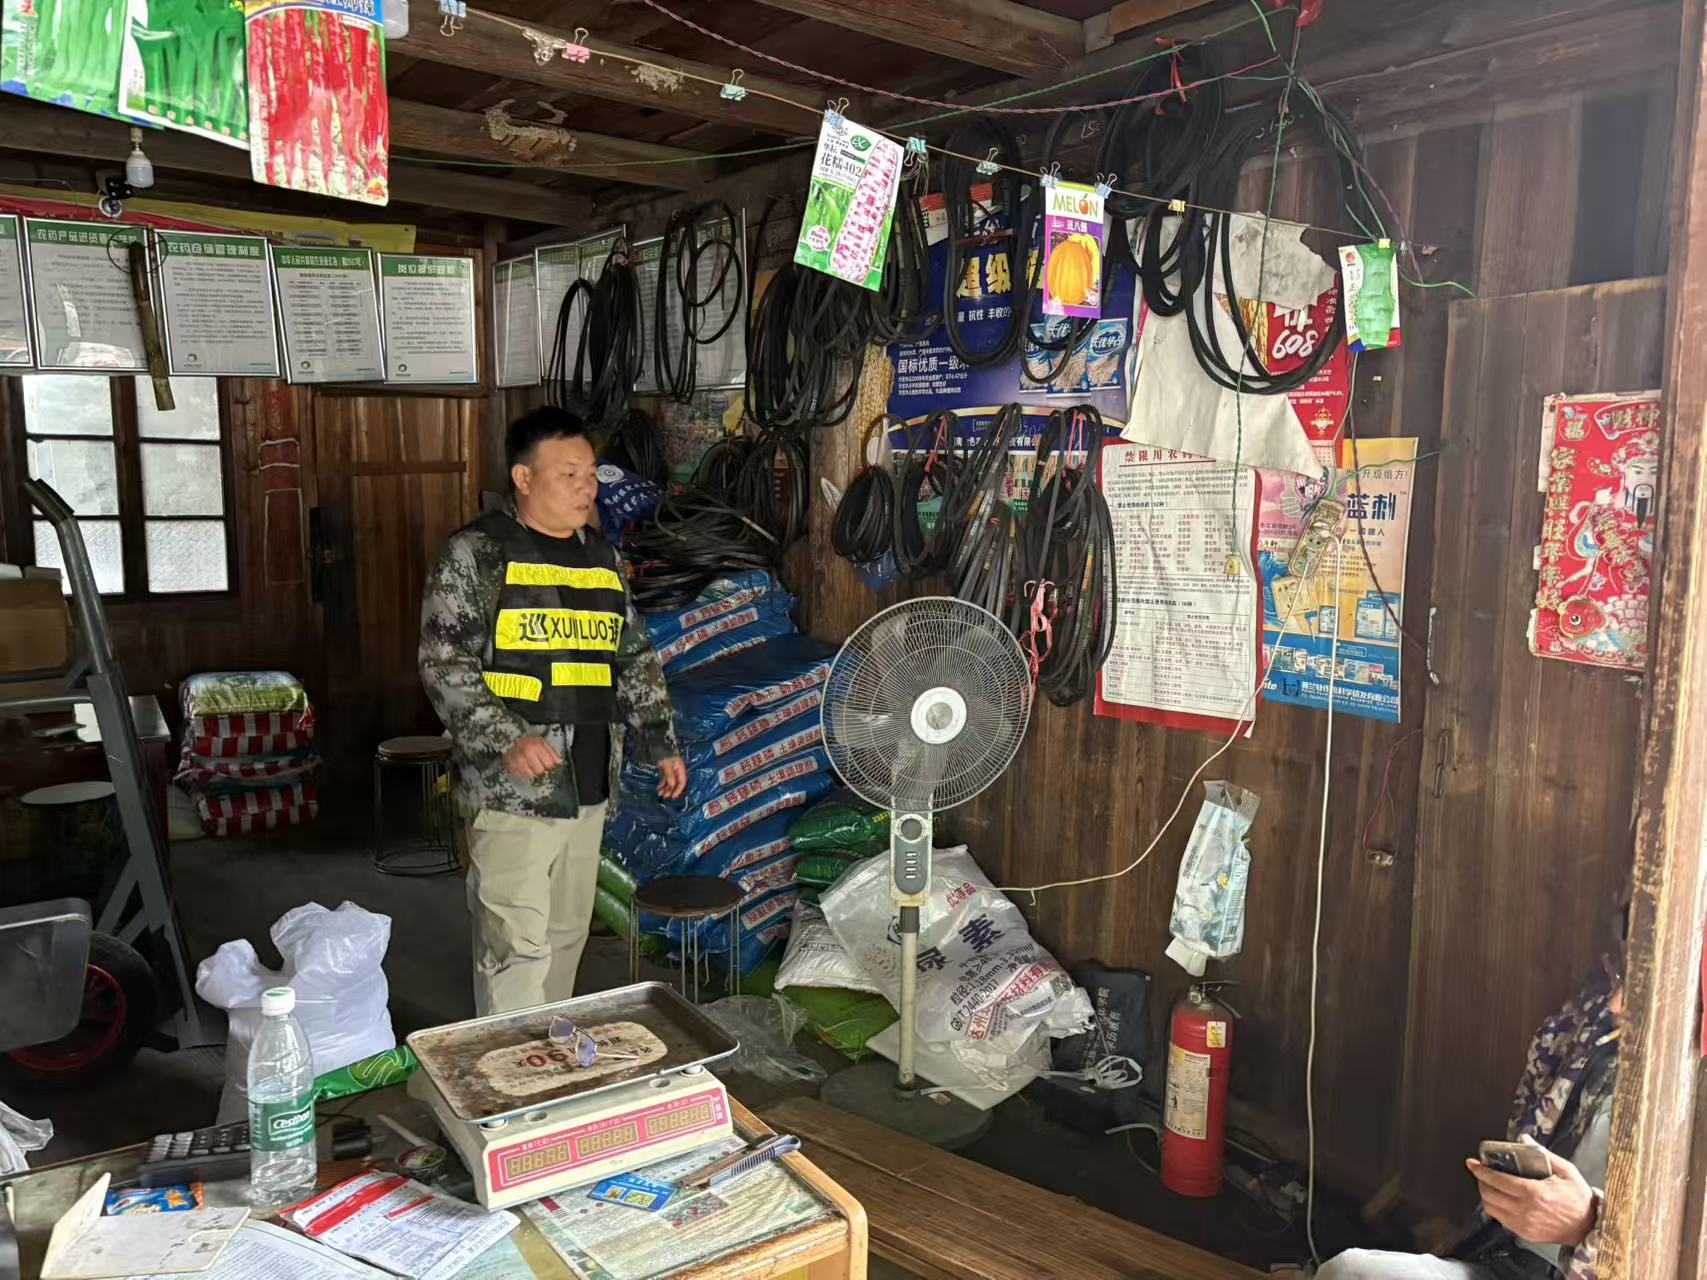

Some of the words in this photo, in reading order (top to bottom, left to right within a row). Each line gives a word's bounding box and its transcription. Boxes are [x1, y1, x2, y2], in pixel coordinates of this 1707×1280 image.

[1052, 193, 1100, 217] MELON
[167, 242, 261, 257] 农药仓储管理制度
[946, 882, 977, 911] 优等品
